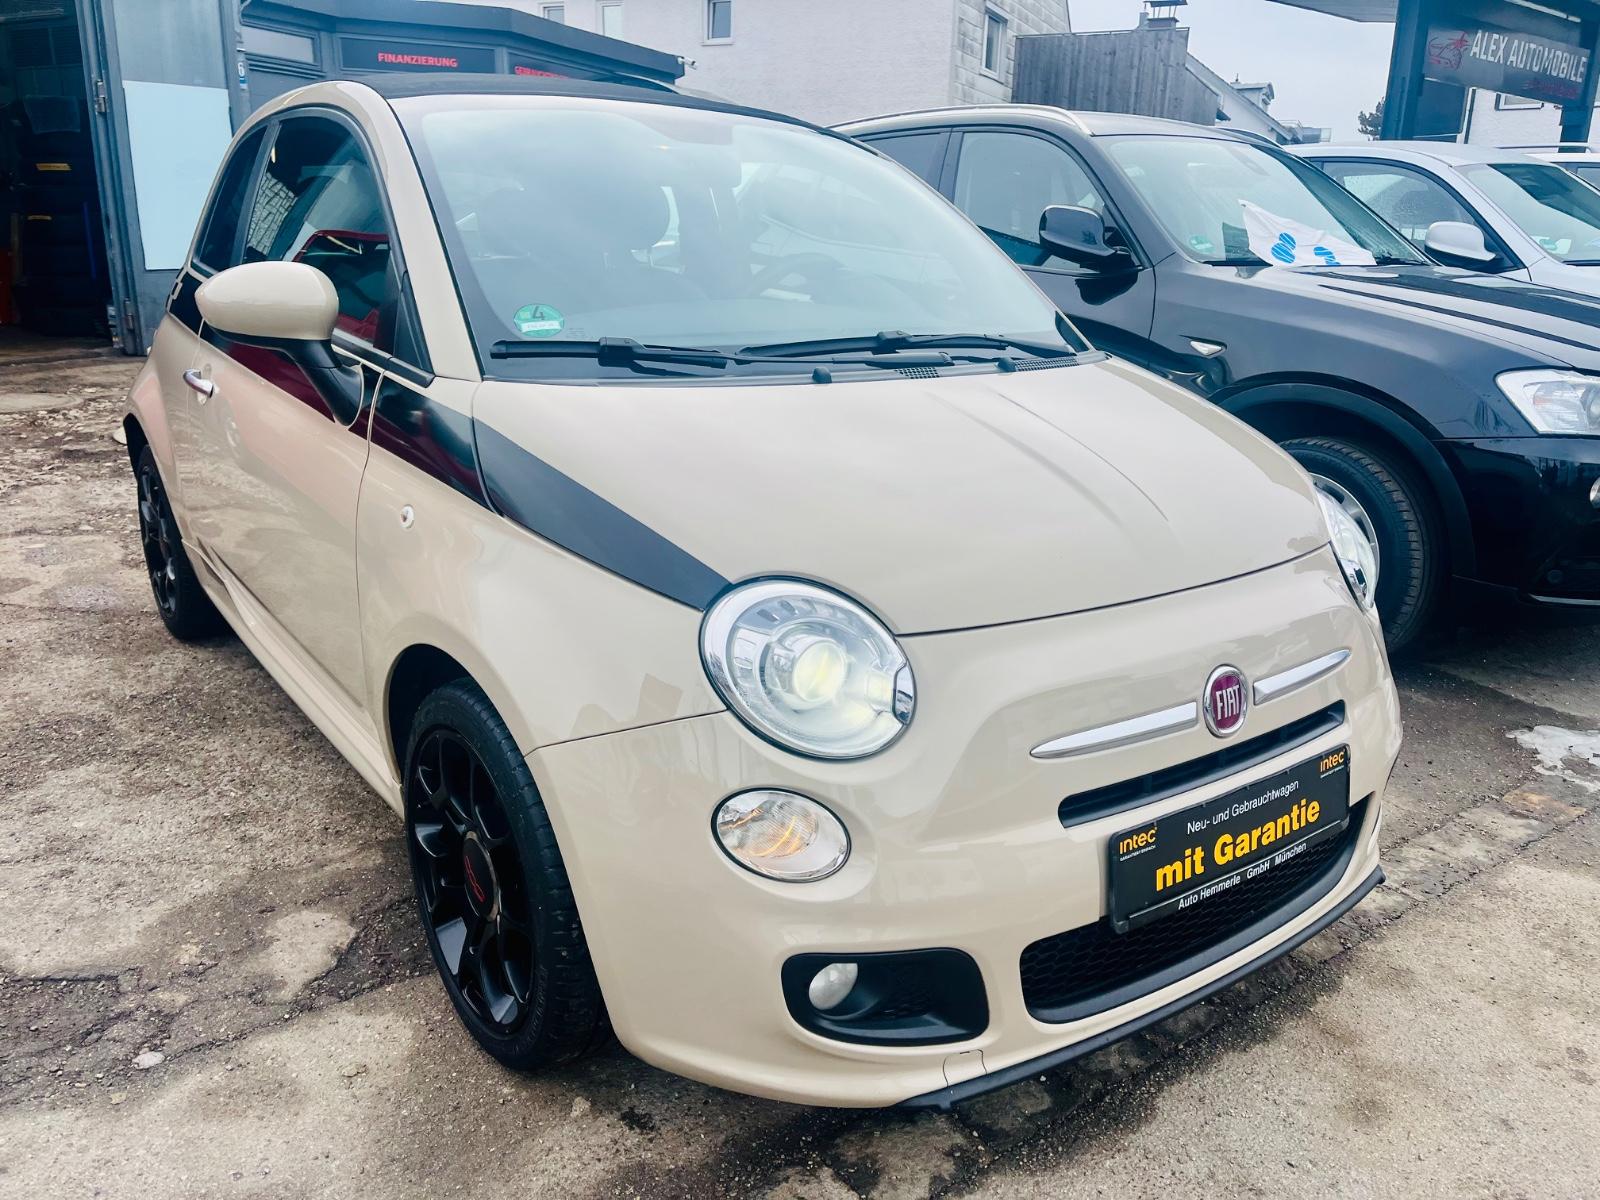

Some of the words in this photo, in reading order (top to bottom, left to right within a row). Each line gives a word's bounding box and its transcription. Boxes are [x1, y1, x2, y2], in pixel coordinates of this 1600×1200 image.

[377, 52, 458, 68] FINANZIERUNG
[1469, 29, 1509, 64] ALEX
[1507, 39, 1588, 83] AUTOMOBILE
[532, 305, 546, 320] 4
[1215, 684, 1240, 721] FIAT
[1320, 751, 1345, 773] intec
[1187, 820, 1211, 835] Neu-
[1212, 808, 1230, 825] und
[1231, 780, 1299, 817] Gebrauchtwagen
[1119, 829, 1157, 855] intec
[1156, 845, 1205, 892] mit
[1213, 798, 1321, 866] Garantie
[1178, 893, 1199, 911] Auto
[1199, 873, 1241, 902] Hemmerle
[1246, 860, 1270, 880] GmbH
[1274, 841, 1307, 866] München
